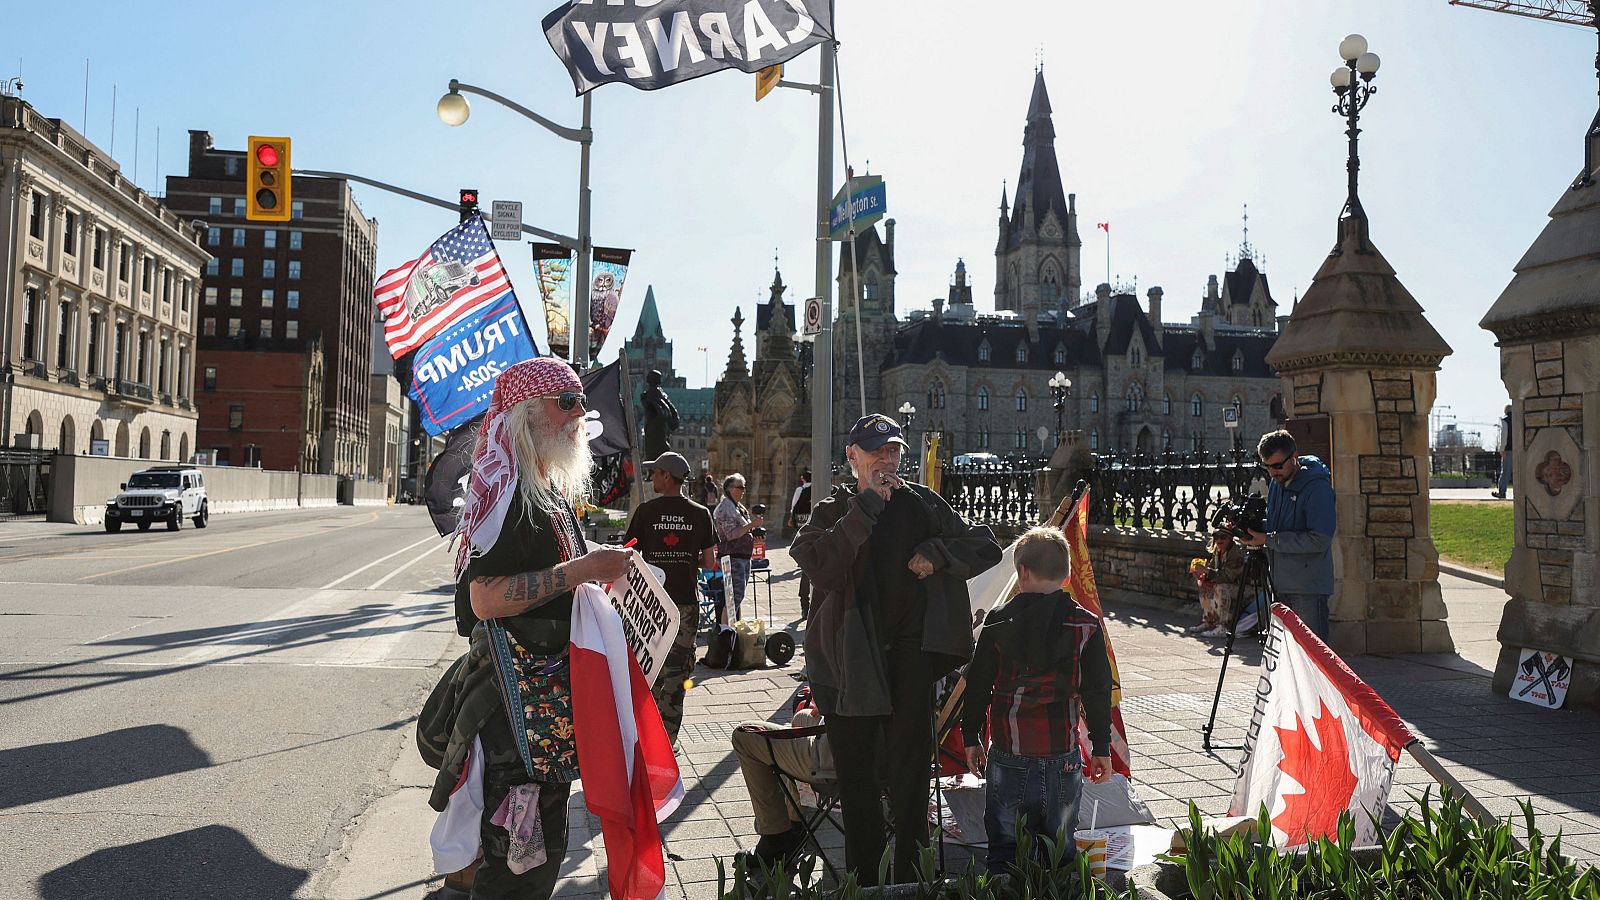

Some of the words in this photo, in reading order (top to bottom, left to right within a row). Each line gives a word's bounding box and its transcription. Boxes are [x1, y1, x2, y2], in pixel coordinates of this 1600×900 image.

[495, 203, 519, 211] BICYCLE
[836, 197, 869, 224] Wellgton
[661, 514, 685, 523] FUCK
[652, 523, 693, 531] TRUDEAU
[627, 560, 671, 636] CHILDREN
[623, 588, 657, 645] CANNOT
[639, 647, 653, 675] TO
[1551, 681, 1569, 690] TAX
[1531, 691, 1547, 699] THE
